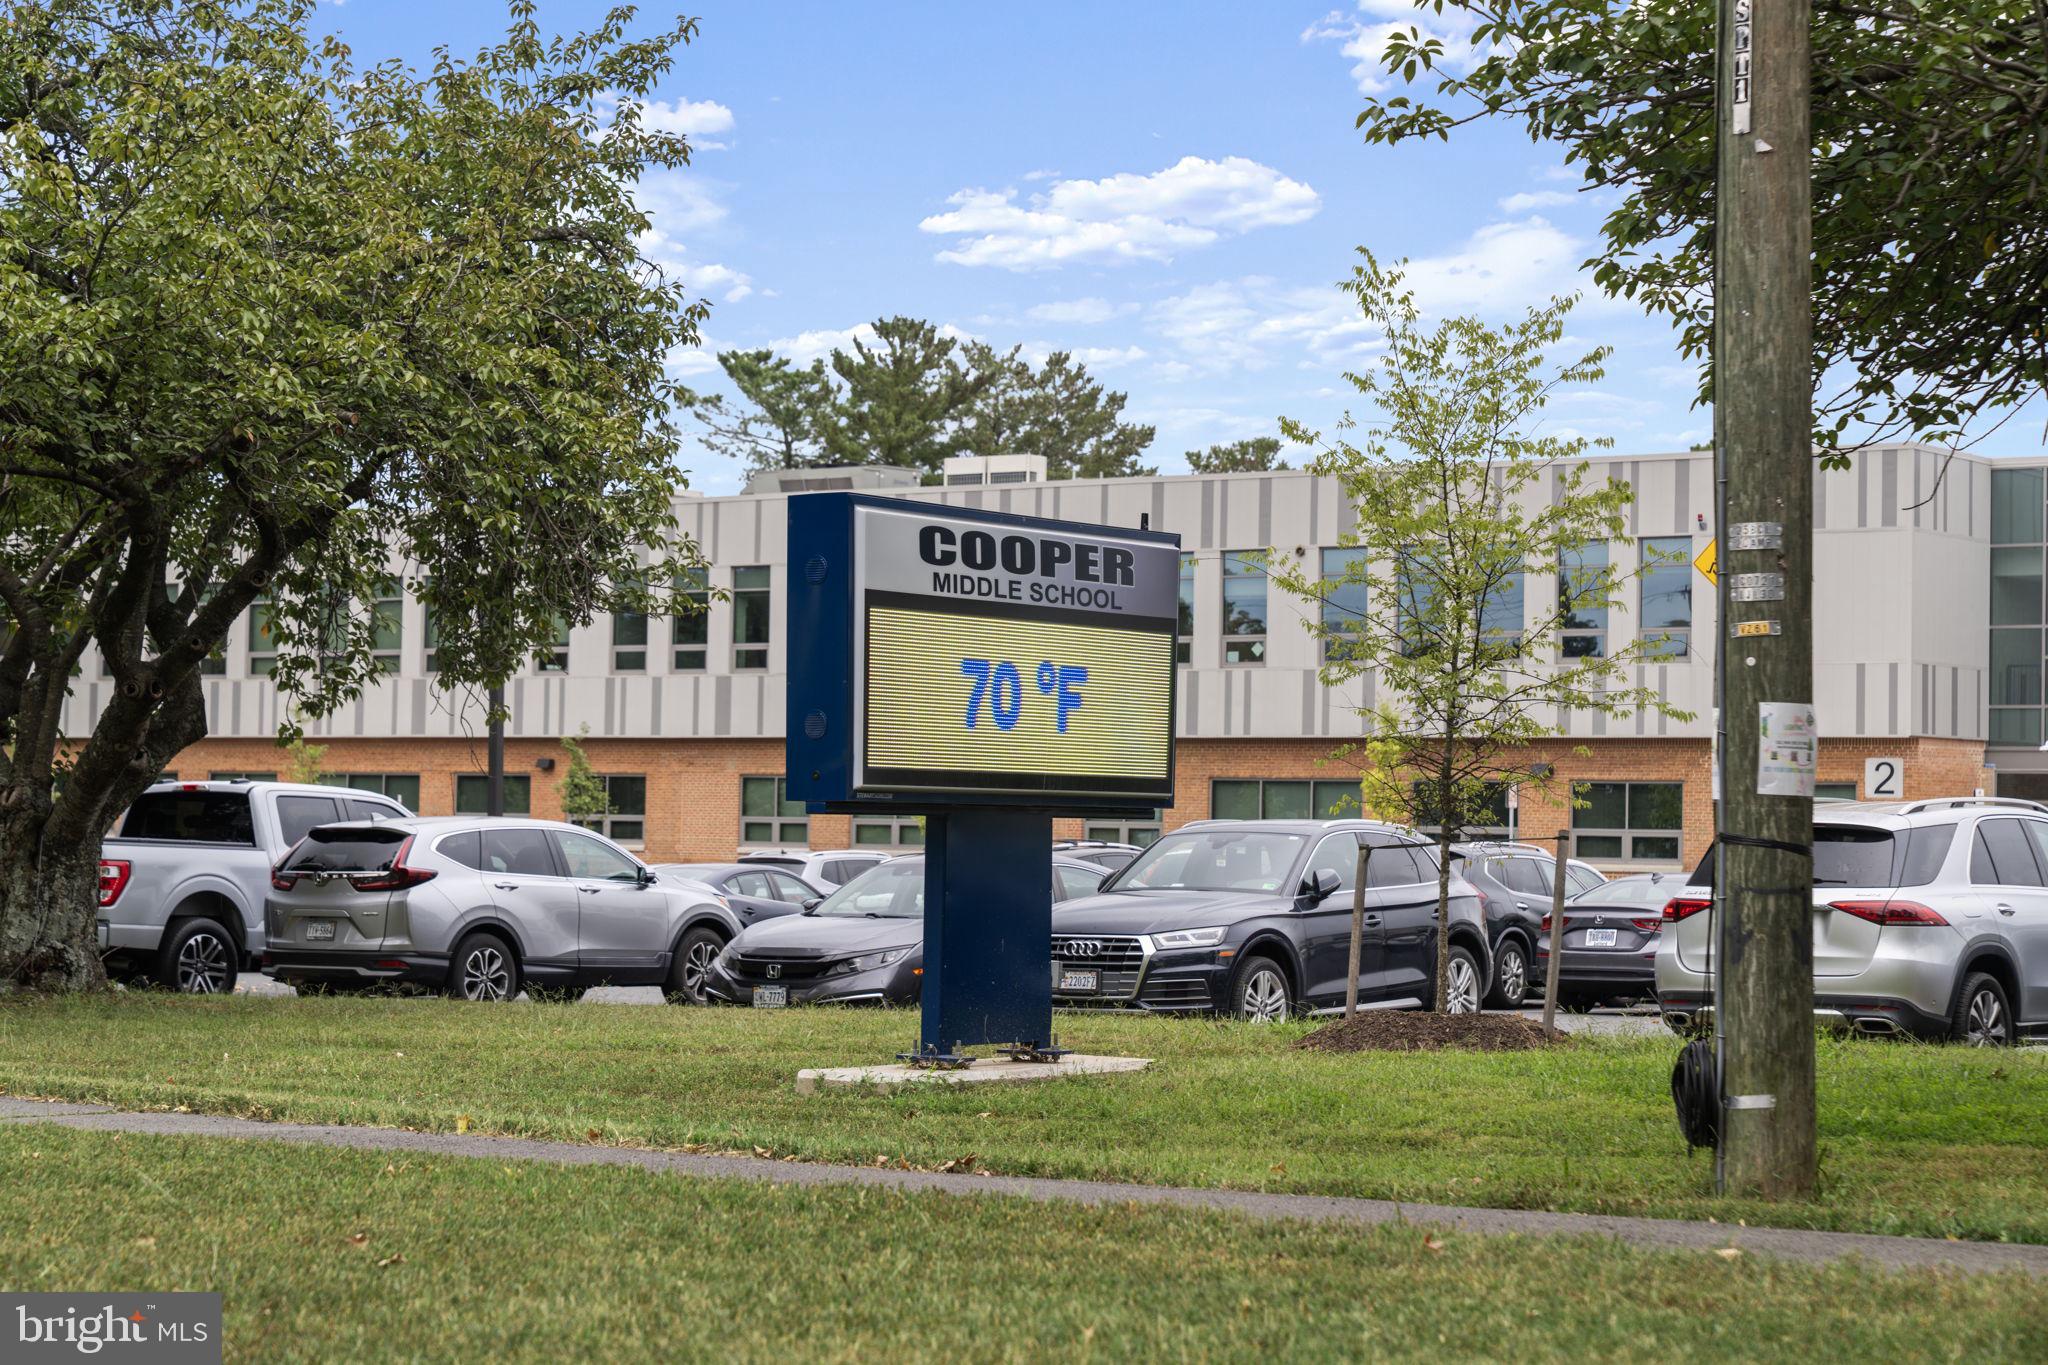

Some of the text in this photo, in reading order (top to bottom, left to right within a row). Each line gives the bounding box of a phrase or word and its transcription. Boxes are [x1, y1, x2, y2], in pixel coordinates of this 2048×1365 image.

[919, 525, 1135, 587] COOPER
[932, 572, 1123, 610] MIDDLE SCHOOL
[960, 658, 1021, 732] 70
[1874, 761, 1895, 794] 2
